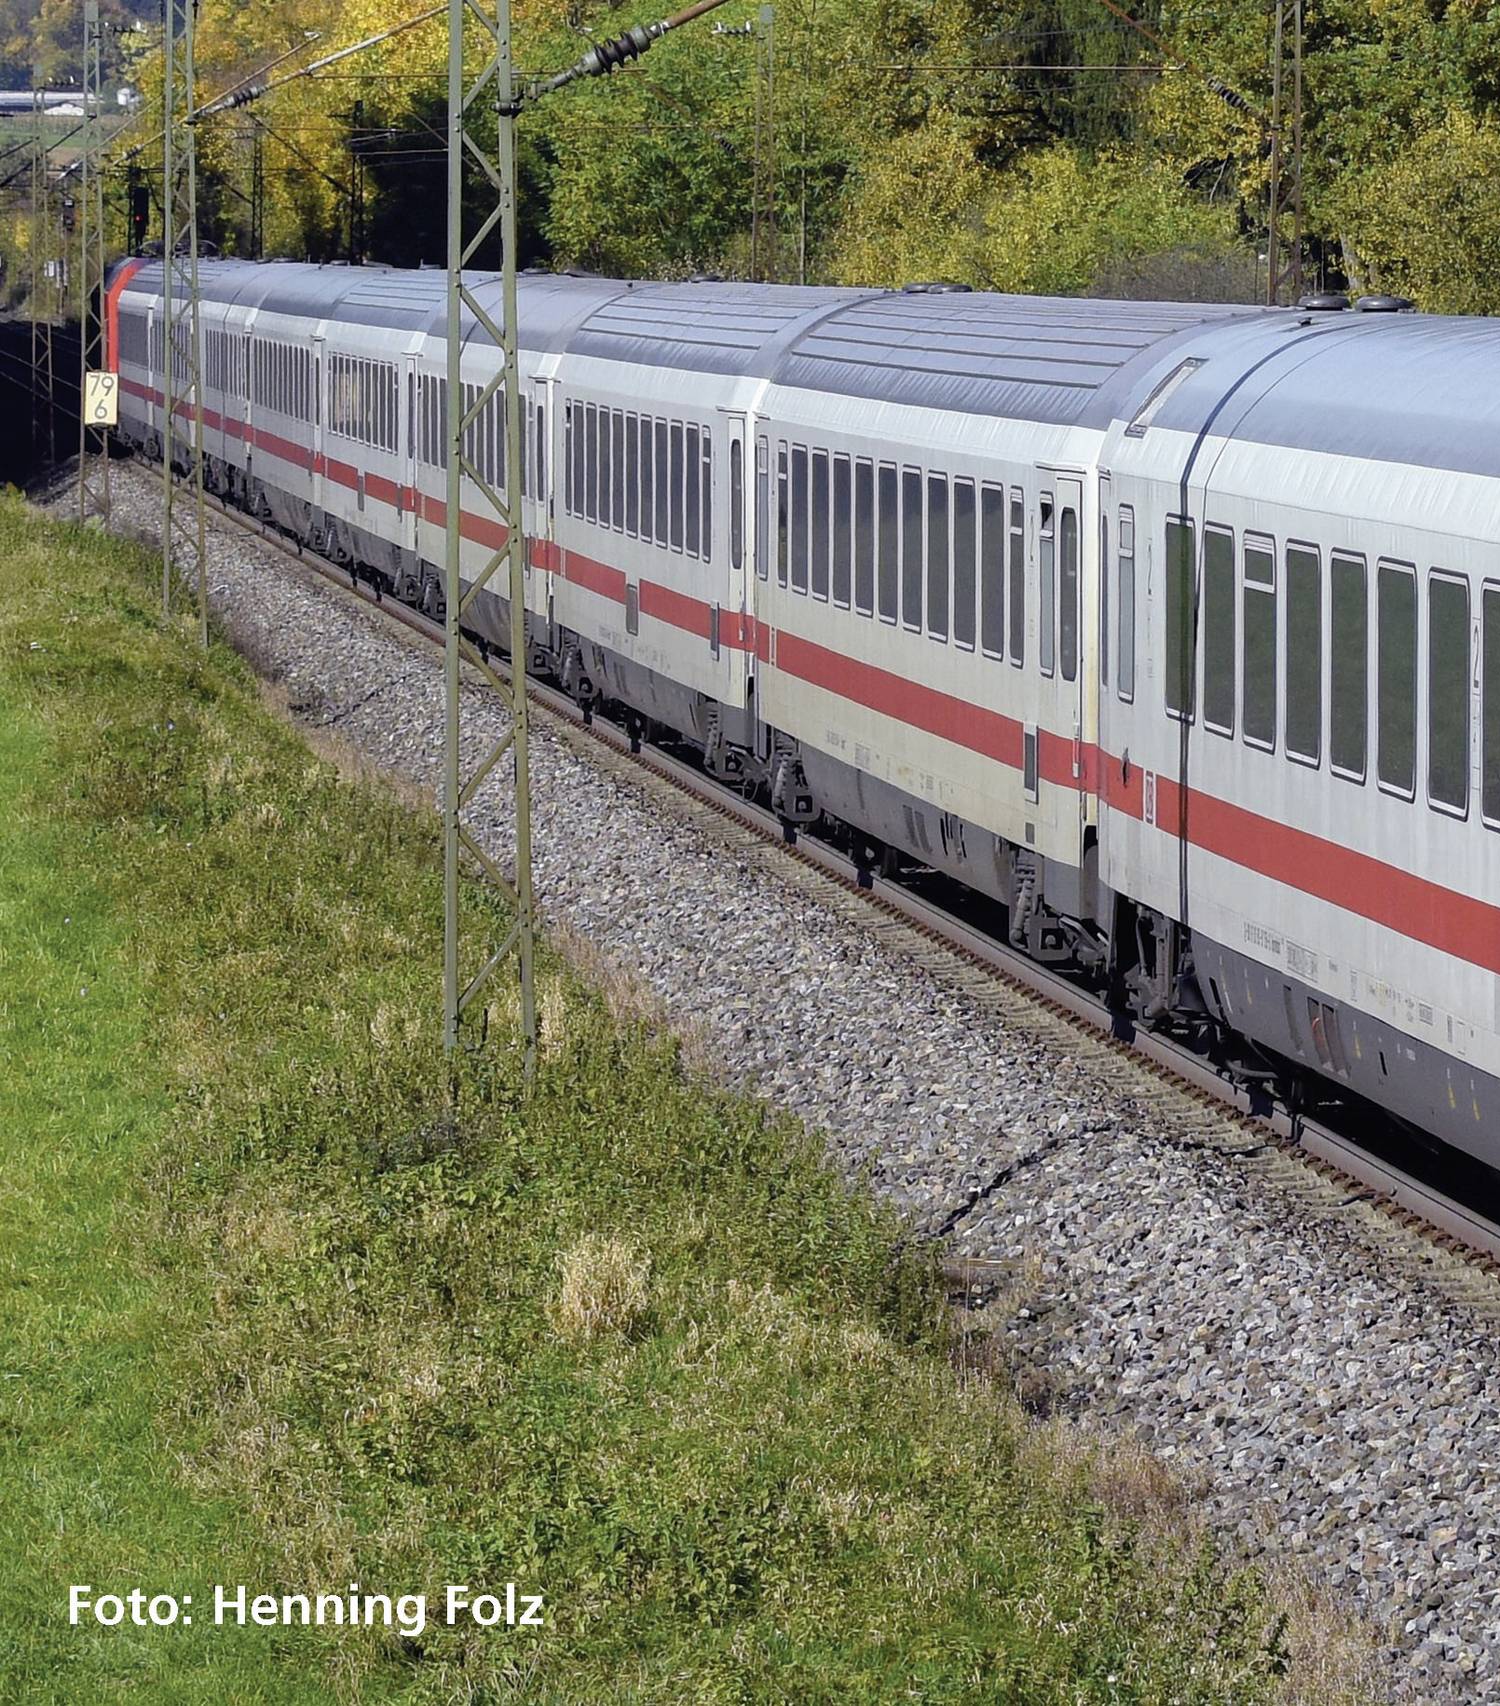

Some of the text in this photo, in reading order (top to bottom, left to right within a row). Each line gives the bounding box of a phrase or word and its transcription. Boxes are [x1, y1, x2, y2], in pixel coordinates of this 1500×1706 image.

[90, 375, 115, 396] 79
[94, 399, 108, 419] 6
[1473, 624, 1480, 688] 2
